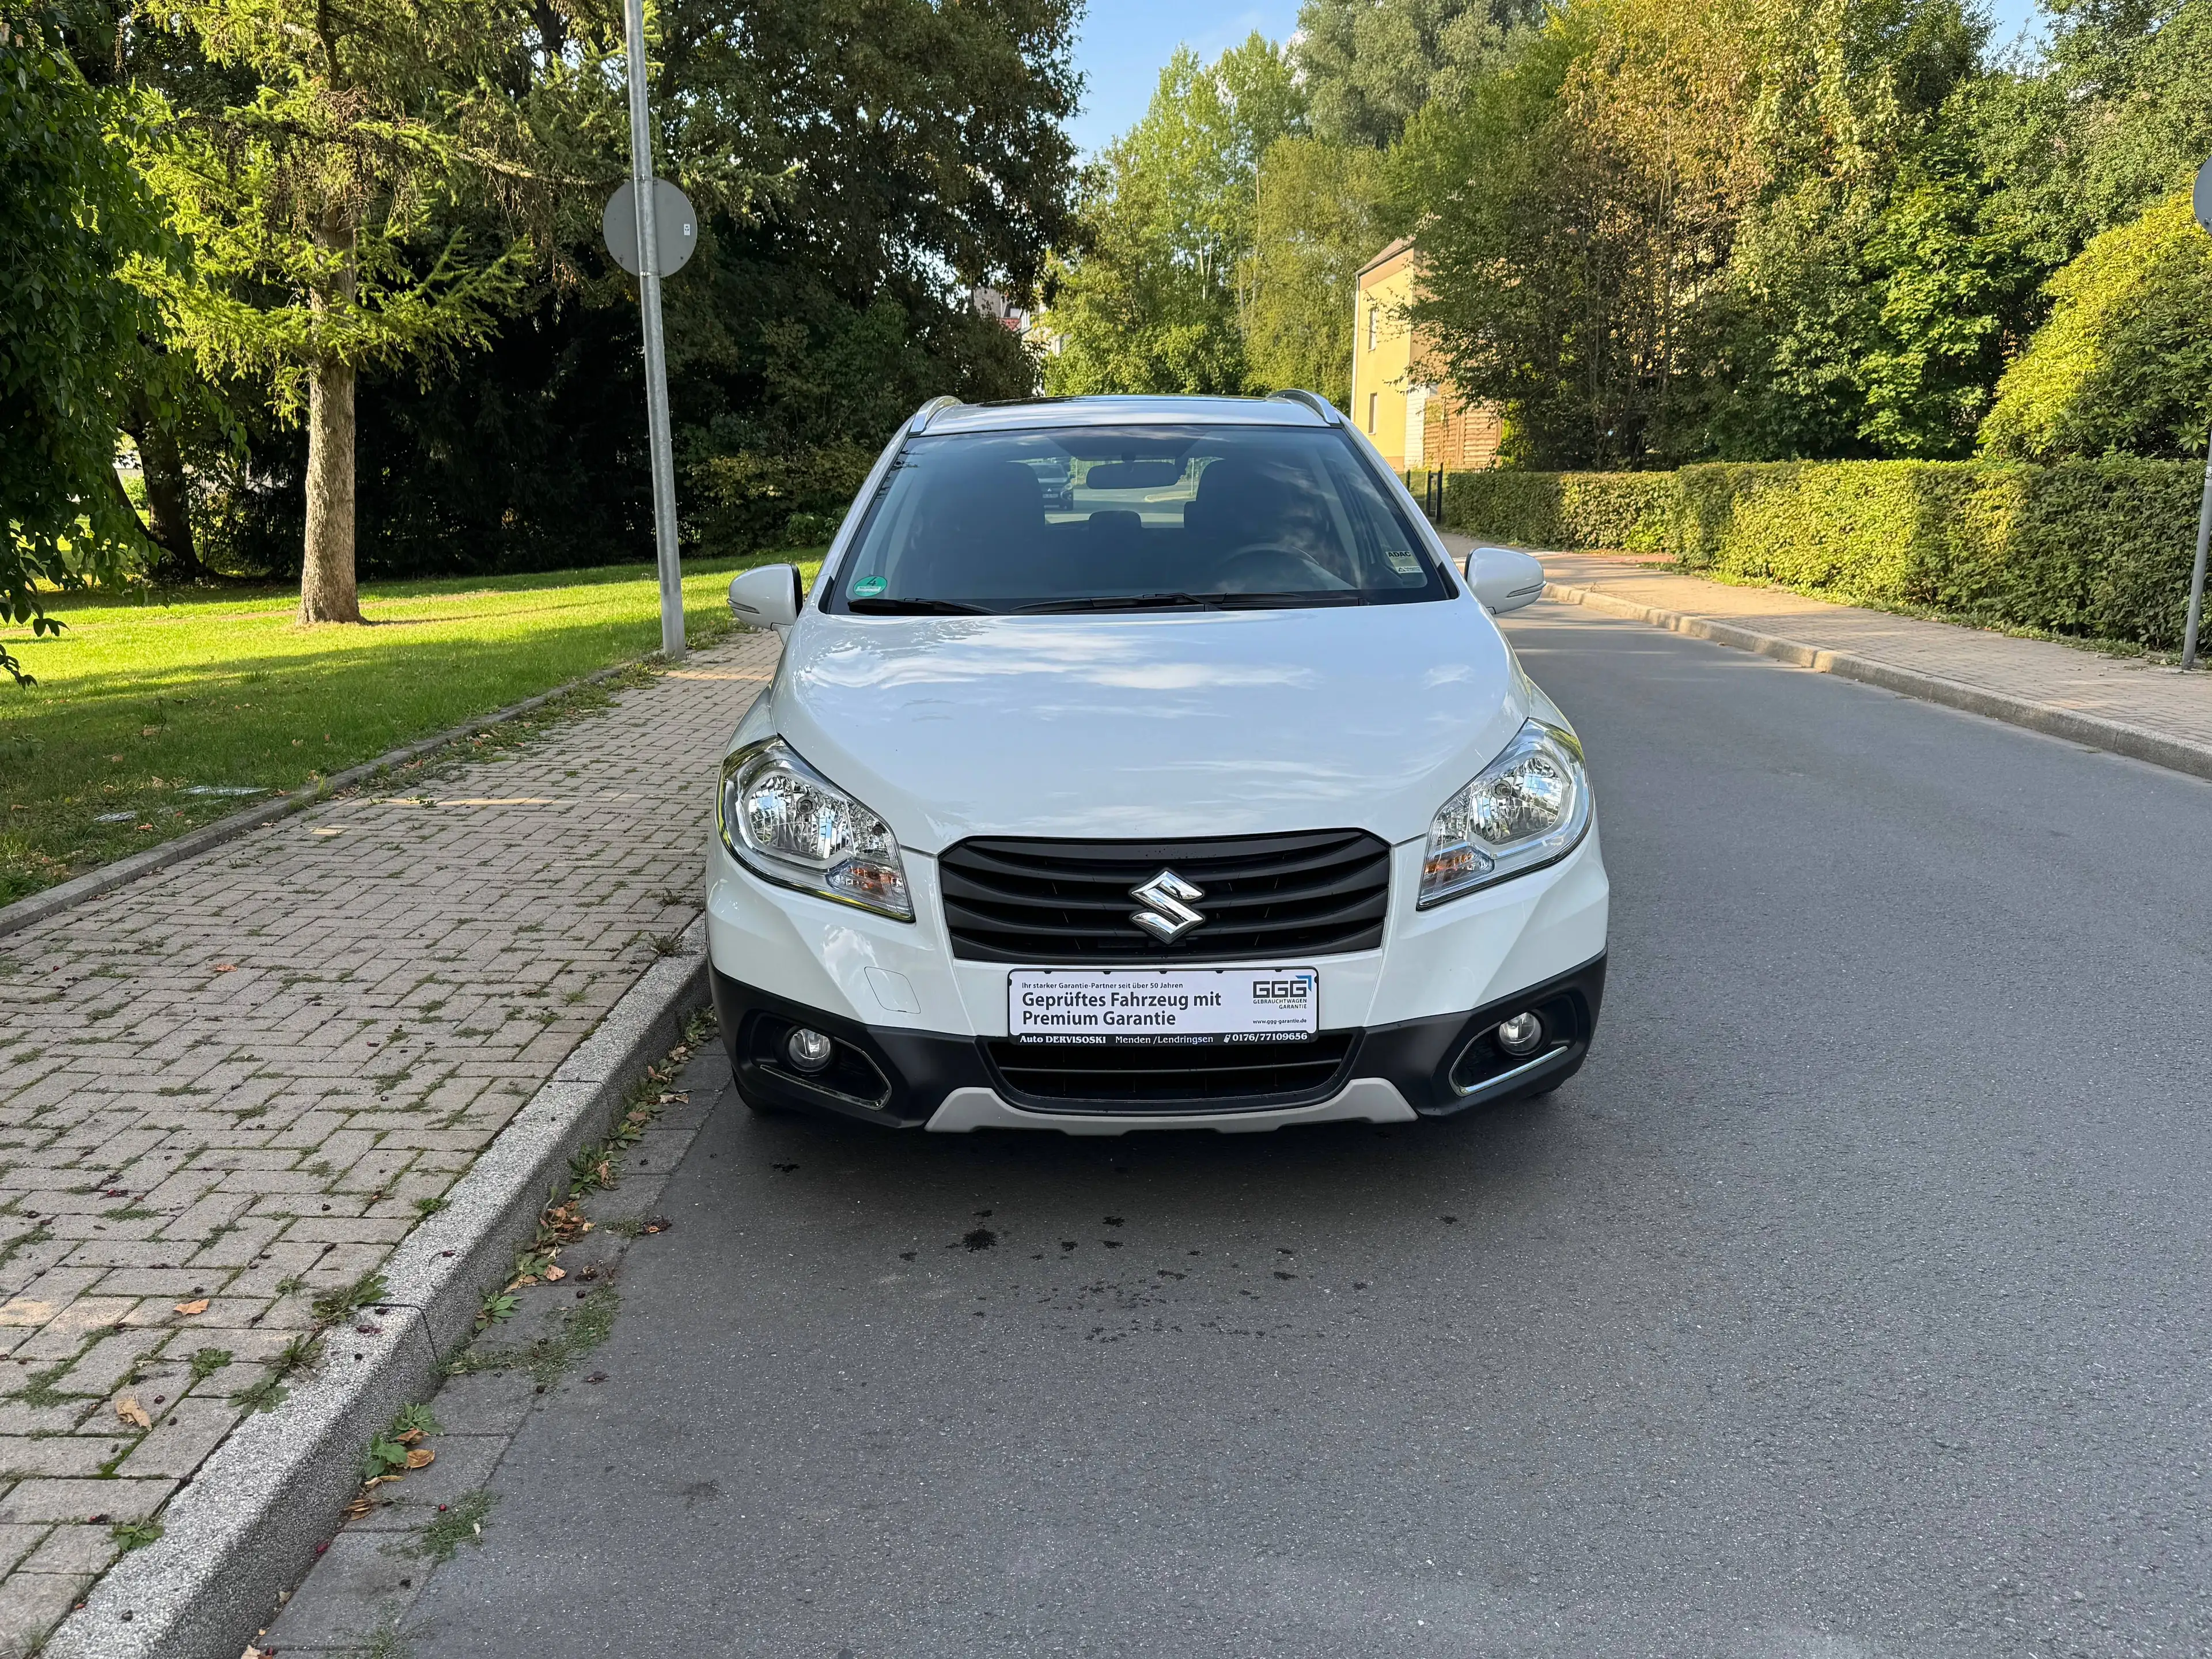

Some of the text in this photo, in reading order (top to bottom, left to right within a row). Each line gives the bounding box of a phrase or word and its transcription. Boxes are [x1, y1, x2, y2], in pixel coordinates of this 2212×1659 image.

[866, 577, 877, 586] 4
[1253, 980, 1307, 998] GGG
[1022, 991, 1221, 1010] Geprüftes Fahrzeug mit
[1022, 1010, 1176, 1025] Premium Garantie
[1020, 1035, 1043, 1044] Auto
[1046, 1036, 1106, 1044] DERVISOSKI
[1232, 1033, 1308, 1042] 0176/77109656
